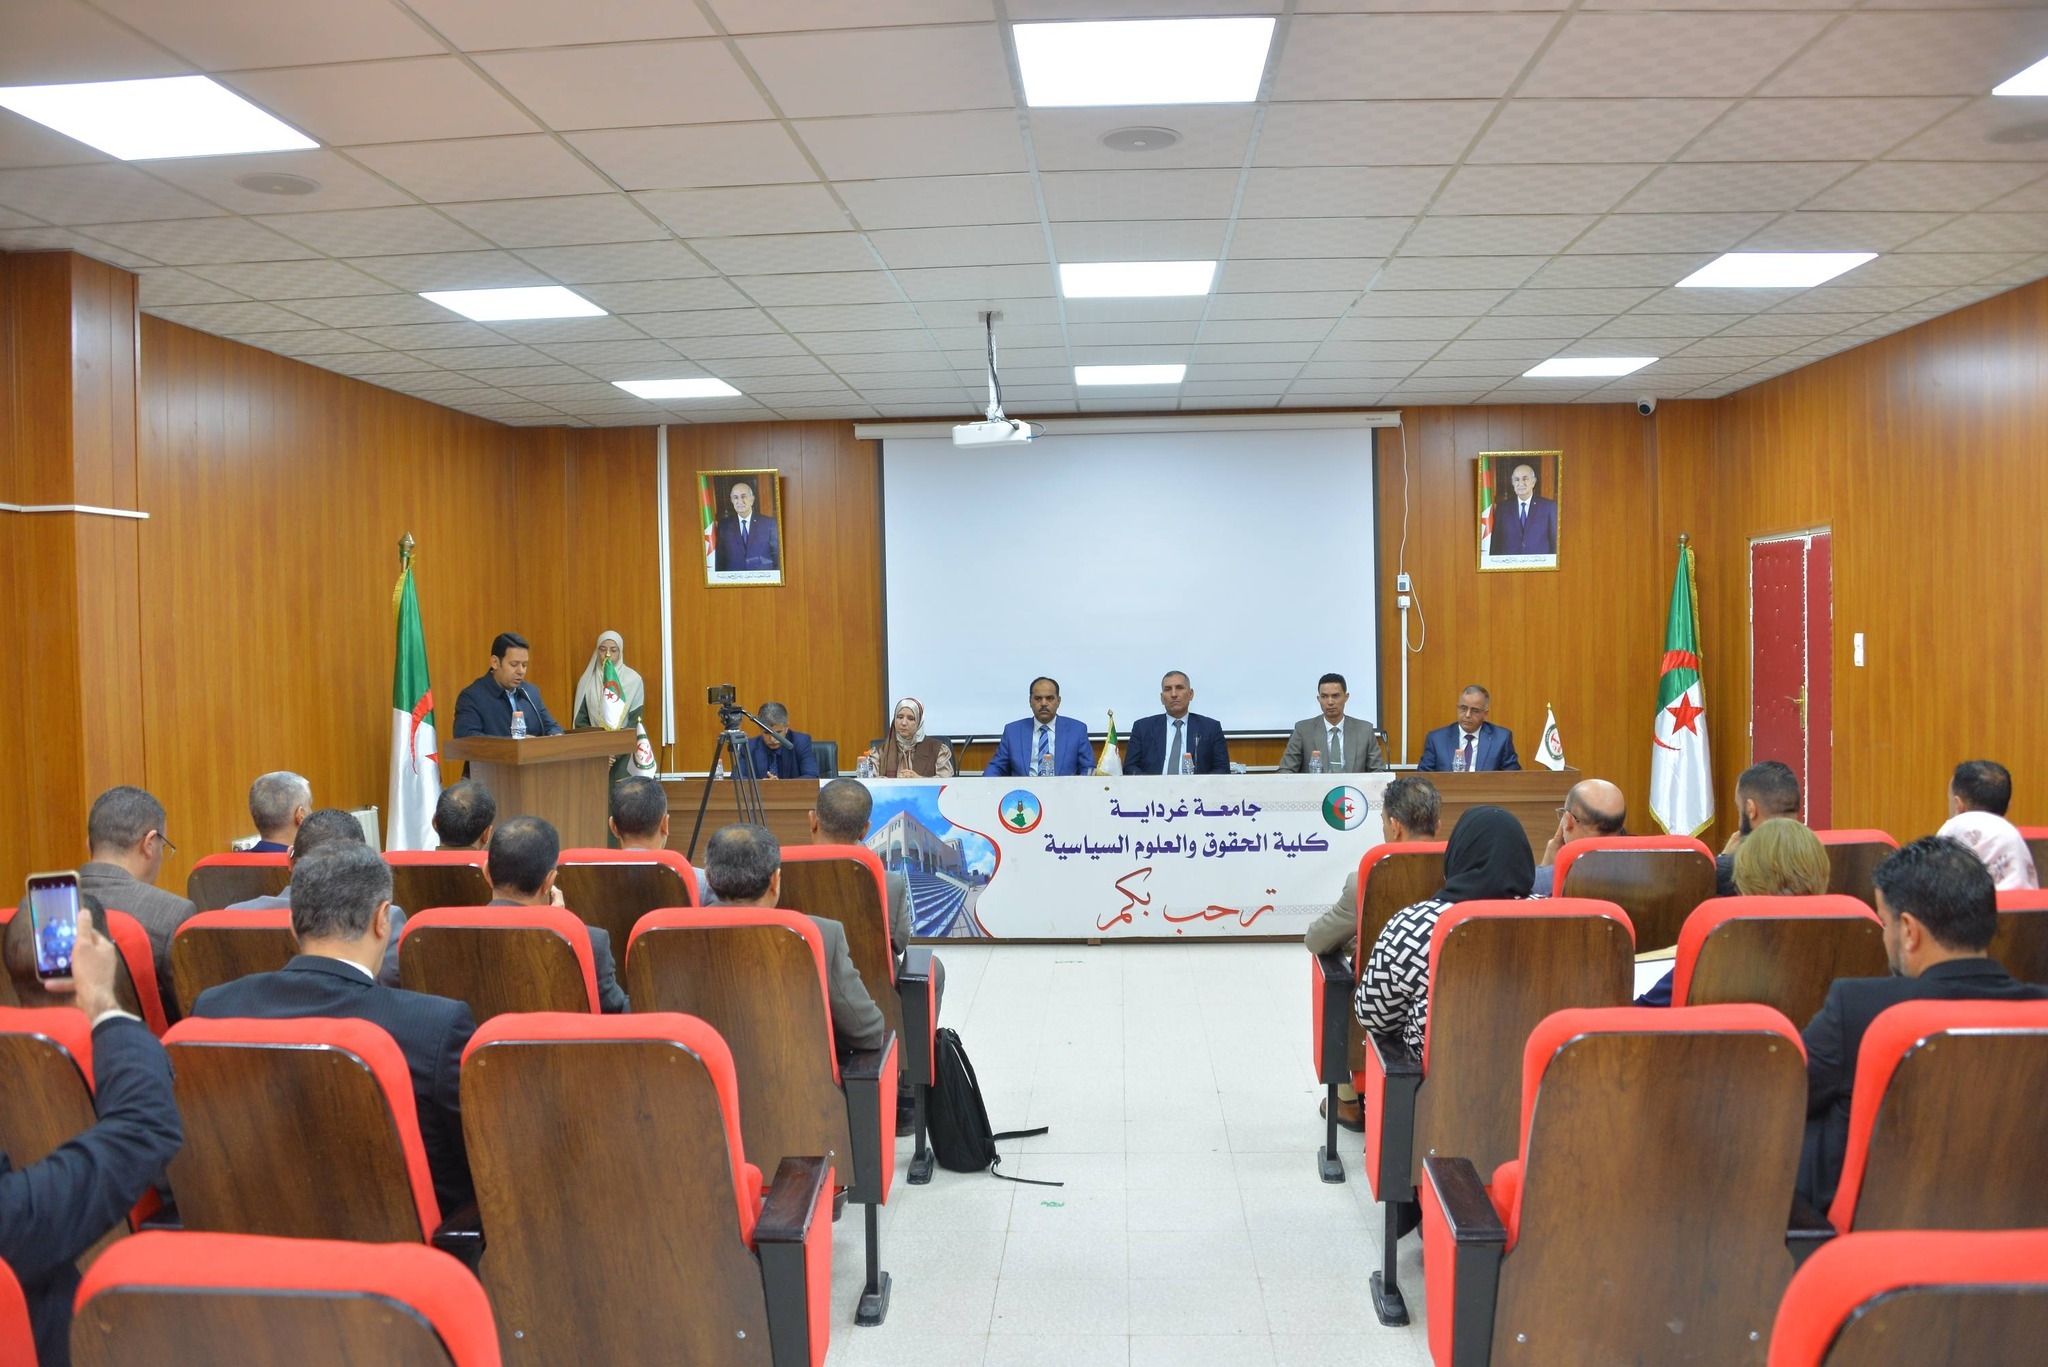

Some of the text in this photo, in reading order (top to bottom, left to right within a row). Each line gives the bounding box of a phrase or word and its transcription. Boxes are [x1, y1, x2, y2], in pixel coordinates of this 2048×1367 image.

[1110, 798, 1262, 824] جامعة غرداية
[1044, 832, 1329, 861] كلية الحقوق والعلوم السياسية
[1096, 866, 1277, 935] ترحب بكم
